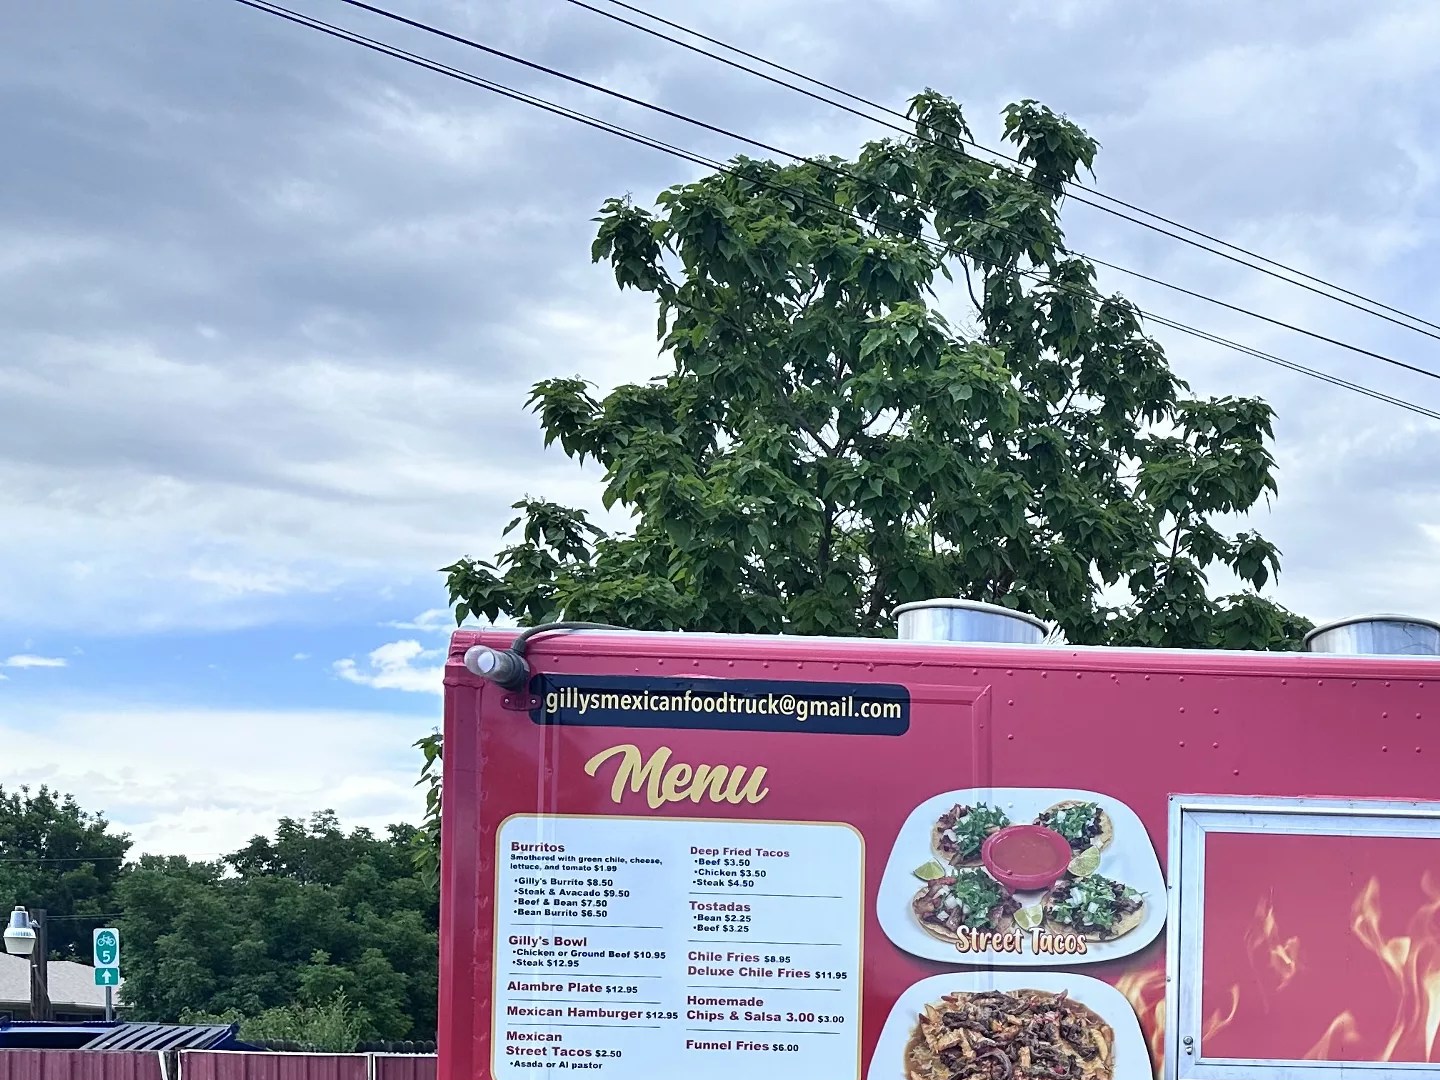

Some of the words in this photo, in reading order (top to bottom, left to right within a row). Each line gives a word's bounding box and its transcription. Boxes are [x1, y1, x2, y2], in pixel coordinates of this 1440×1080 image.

[546, 688, 901, 722] gillysmexicanfoodtruck@gmail.com
[584, 744, 769, 809] Menu
[511, 842, 565, 852] Burritos
[690, 846, 719, 857] Deep
[723, 847, 751, 856] Fried
[755, 848, 790, 858] Tacos
[699, 858, 720, 866] Beef
[724, 859, 750, 867] $3.50
[740, 869, 766, 877] $3.50
[519, 878, 547, 886] Gilly's
[550, 878, 583, 886] Burrito
[587, 879, 613, 887] $8.50
[697, 879, 725, 887] Steak
[559, 889, 600, 897] Avacado
[604, 890, 630, 898] $9.50
[581, 899, 607, 908] $7.50
[689, 901, 751, 912] Tostadas
[544, 909, 578, 917] Burrito
[581, 910, 607, 918] $6.50
[698, 914, 722, 922] Bean
[725, 914, 751, 922] $2.25
[697, 924, 719, 932] Beef
[723, 925, 749, 933] $3.25
[508, 936, 549, 948] Gilly's
[554, 937, 587, 947] Bowl
[956, 925, 1023, 953] Street
[1029, 927, 1087, 954] Tacos
[102, 951, 110, 962] 5
[517, 948, 555, 957] Chicken
[570, 950, 605, 958] Ground
[608, 950, 630, 958] Beef
[633, 951, 666, 959] $10.95
[688, 951, 722, 962] Chile
[727, 952, 760, 962] Fries
[547, 959, 579, 968] $12.95
[687, 966, 734, 976] Deluxe
[739, 967, 773, 978] Chile
[778, 968, 811, 978] Fries
[815, 971, 847, 979] $11.95
[507, 981, 563, 992] Alambre
[568, 982, 602, 992] Plate
[606, 985, 637, 994] $12.95
[687, 995, 764, 1007] Homemade
[507, 1006, 563, 1017] Mexican
[568, 1007, 643, 1020] Hamburger
[646, 1011, 678, 1020] $12.95
[686, 1010, 724, 1022] Chips
[729, 1011, 739, 1021] &
[744, 1011, 781, 1022] Salsa
[786, 1013, 815, 1022] 3.00
[506, 1031, 562, 1042] Mexican
[686, 1040, 731, 1050] Funnel
[736, 1041, 769, 1051] Fries
[772, 1044, 799, 1052] $6.00
[506, 1046, 547, 1056] Street
[552, 1046, 592, 1057] Tacos
[595, 1050, 622, 1058] $2.50
[514, 1060, 542, 1068] Asada
[572, 1062, 602, 1070] pastor
